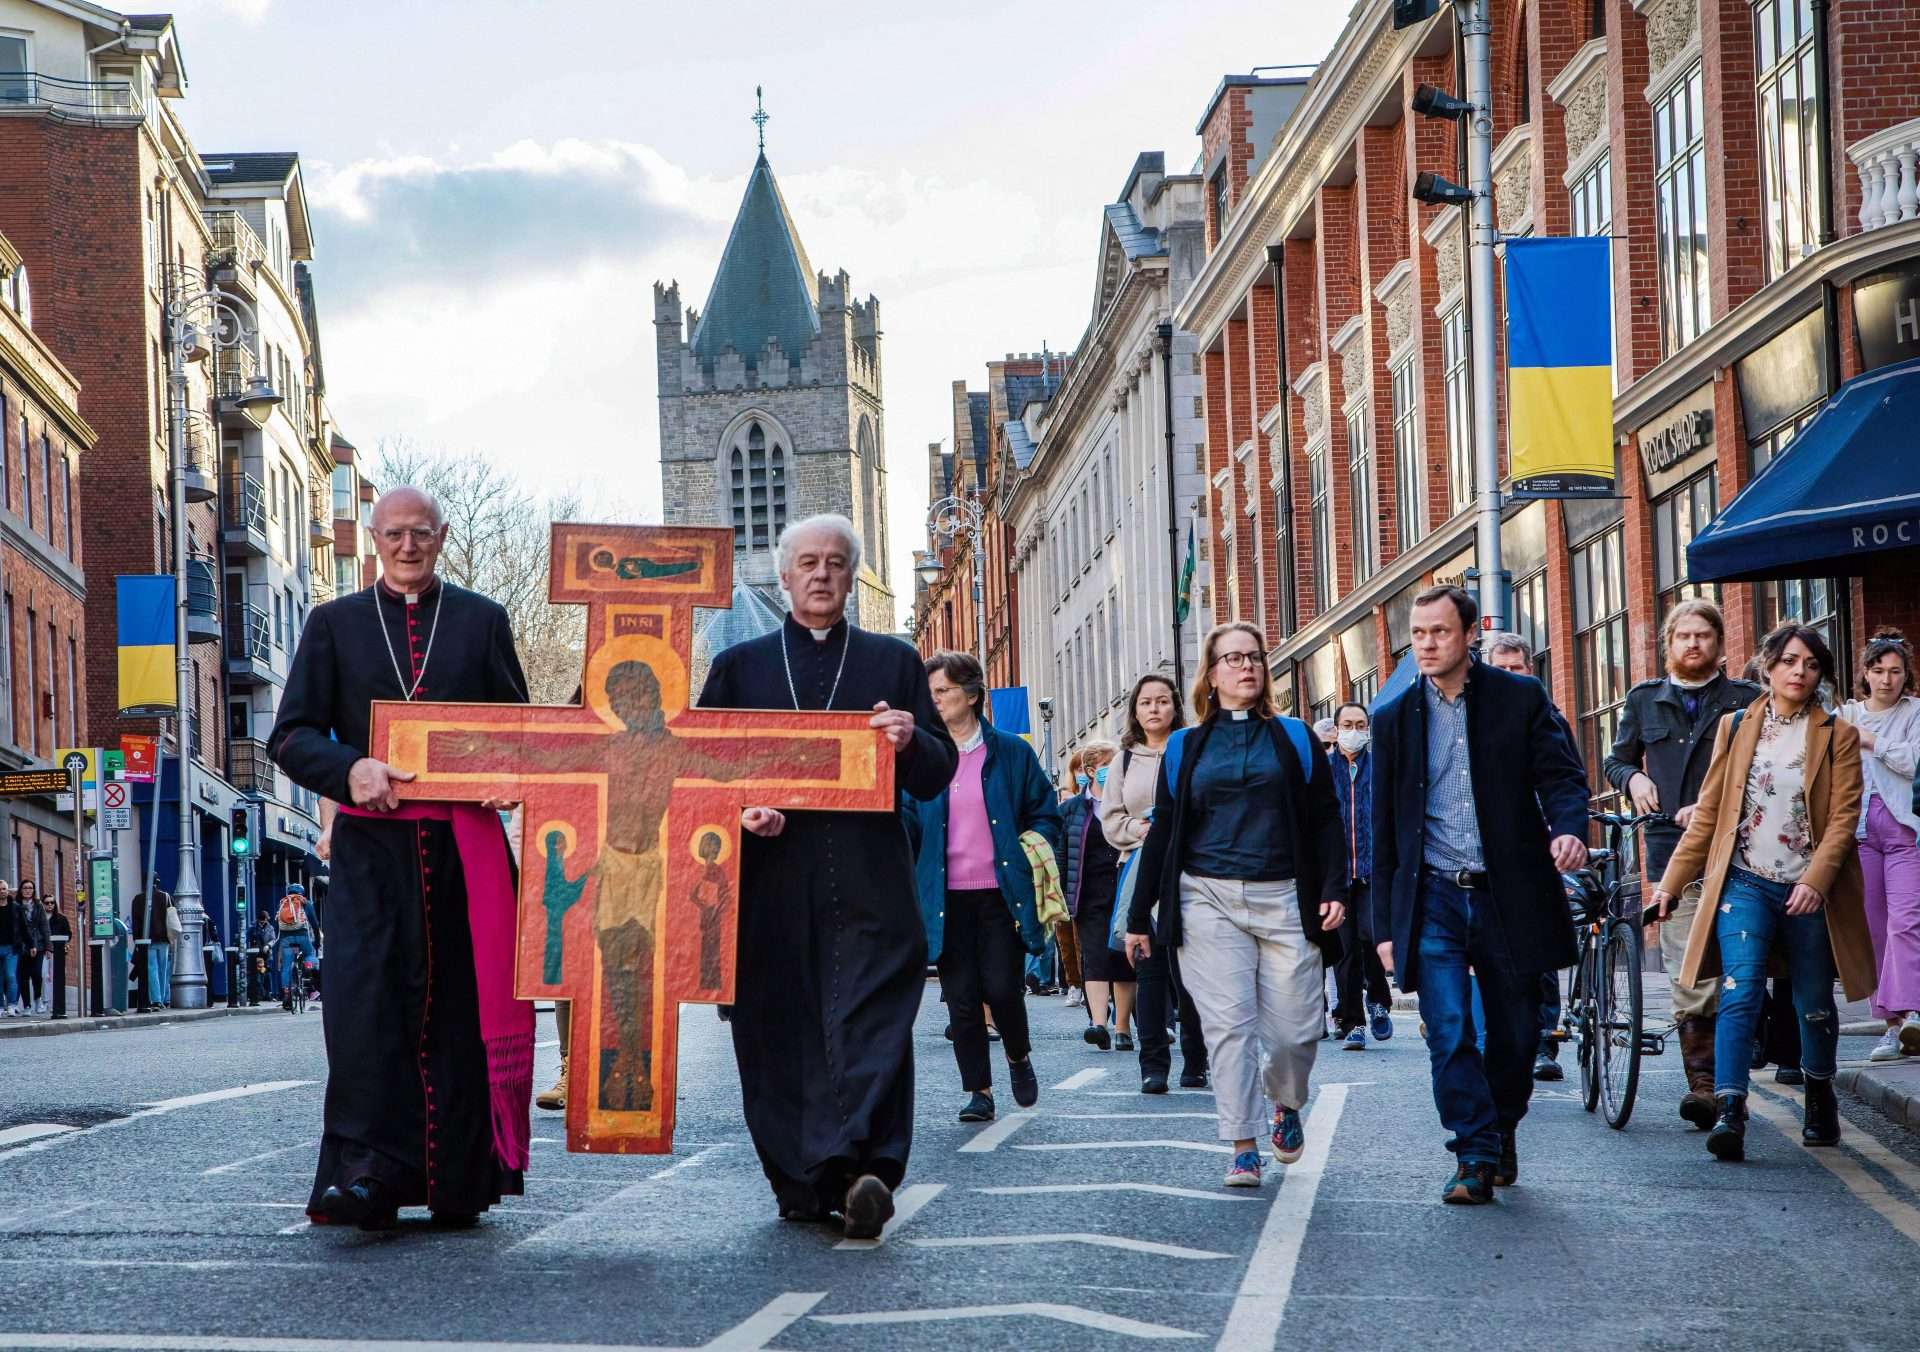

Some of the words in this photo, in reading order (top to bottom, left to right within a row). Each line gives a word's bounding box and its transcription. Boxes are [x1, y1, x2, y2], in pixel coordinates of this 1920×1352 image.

[1643, 428, 1671, 475] ROCK
[1669, 411, 1700, 460] SHOP
[1852, 519, 1920, 548] ROC
[620, 616, 653, 627] INRI
